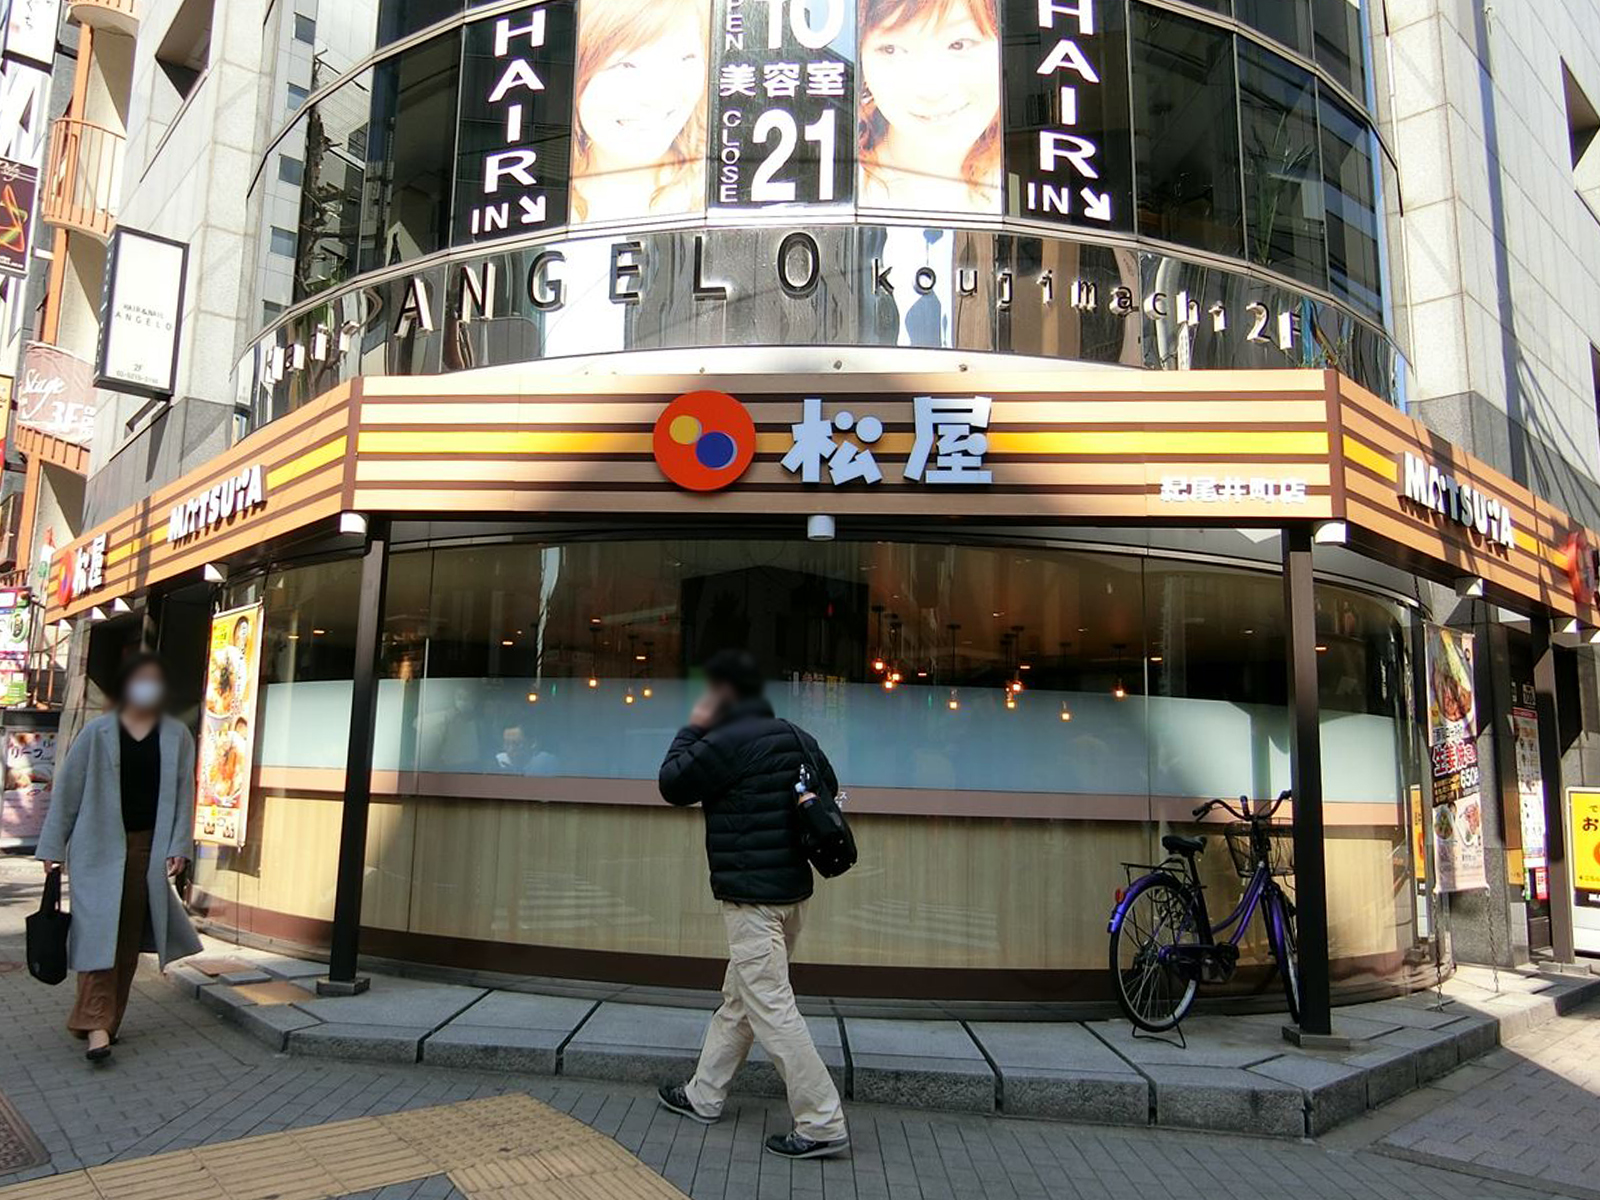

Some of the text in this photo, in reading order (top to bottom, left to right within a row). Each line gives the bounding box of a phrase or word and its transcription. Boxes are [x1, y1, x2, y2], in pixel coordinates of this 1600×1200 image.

[484, 9, 546, 193] HAIR
[719, 61, 845, 98] 美容室
[1036, 0, 1099, 179] HAIR
[719, 110, 741, 202] CLOSE
[751, 108, 836, 201] 21
[1027, 182, 1069, 214] IN
[471, 203, 509, 234] IN
[115, 311, 173, 331] ANGELO
[400, 231, 820, 337] ANGELO
[781, 396, 993, 485] 松屋
[167, 464, 264, 542] MATSUYA
[1400, 451, 1515, 549] MATSUYA
